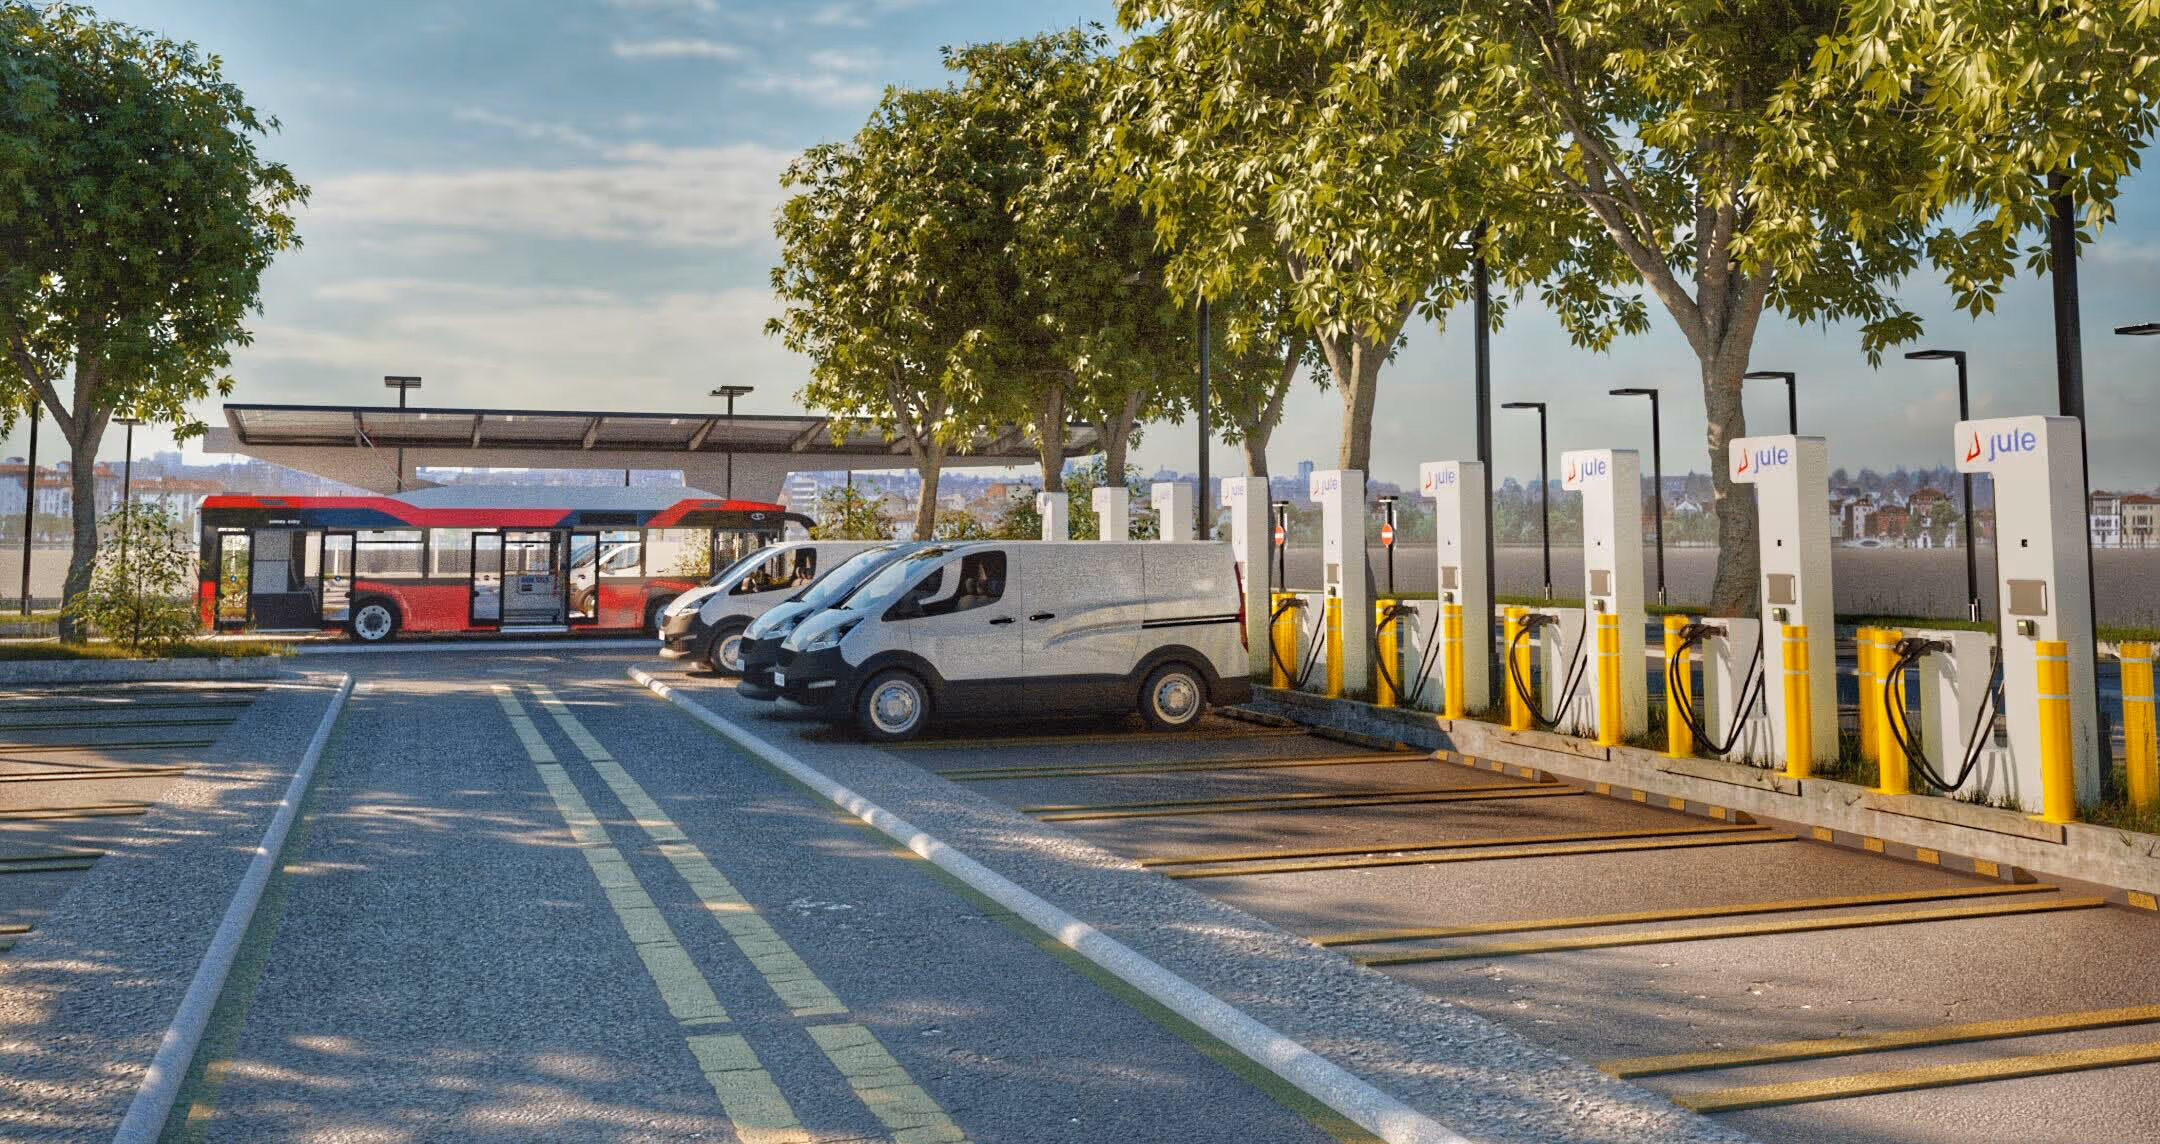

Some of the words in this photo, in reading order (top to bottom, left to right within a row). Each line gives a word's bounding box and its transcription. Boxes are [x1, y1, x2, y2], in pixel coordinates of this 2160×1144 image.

[1988, 427, 2036, 462] jule
[1580, 456, 1607, 482] jule
[1753, 446, 1789, 474] jule
[1435, 467, 1456, 489] jule
